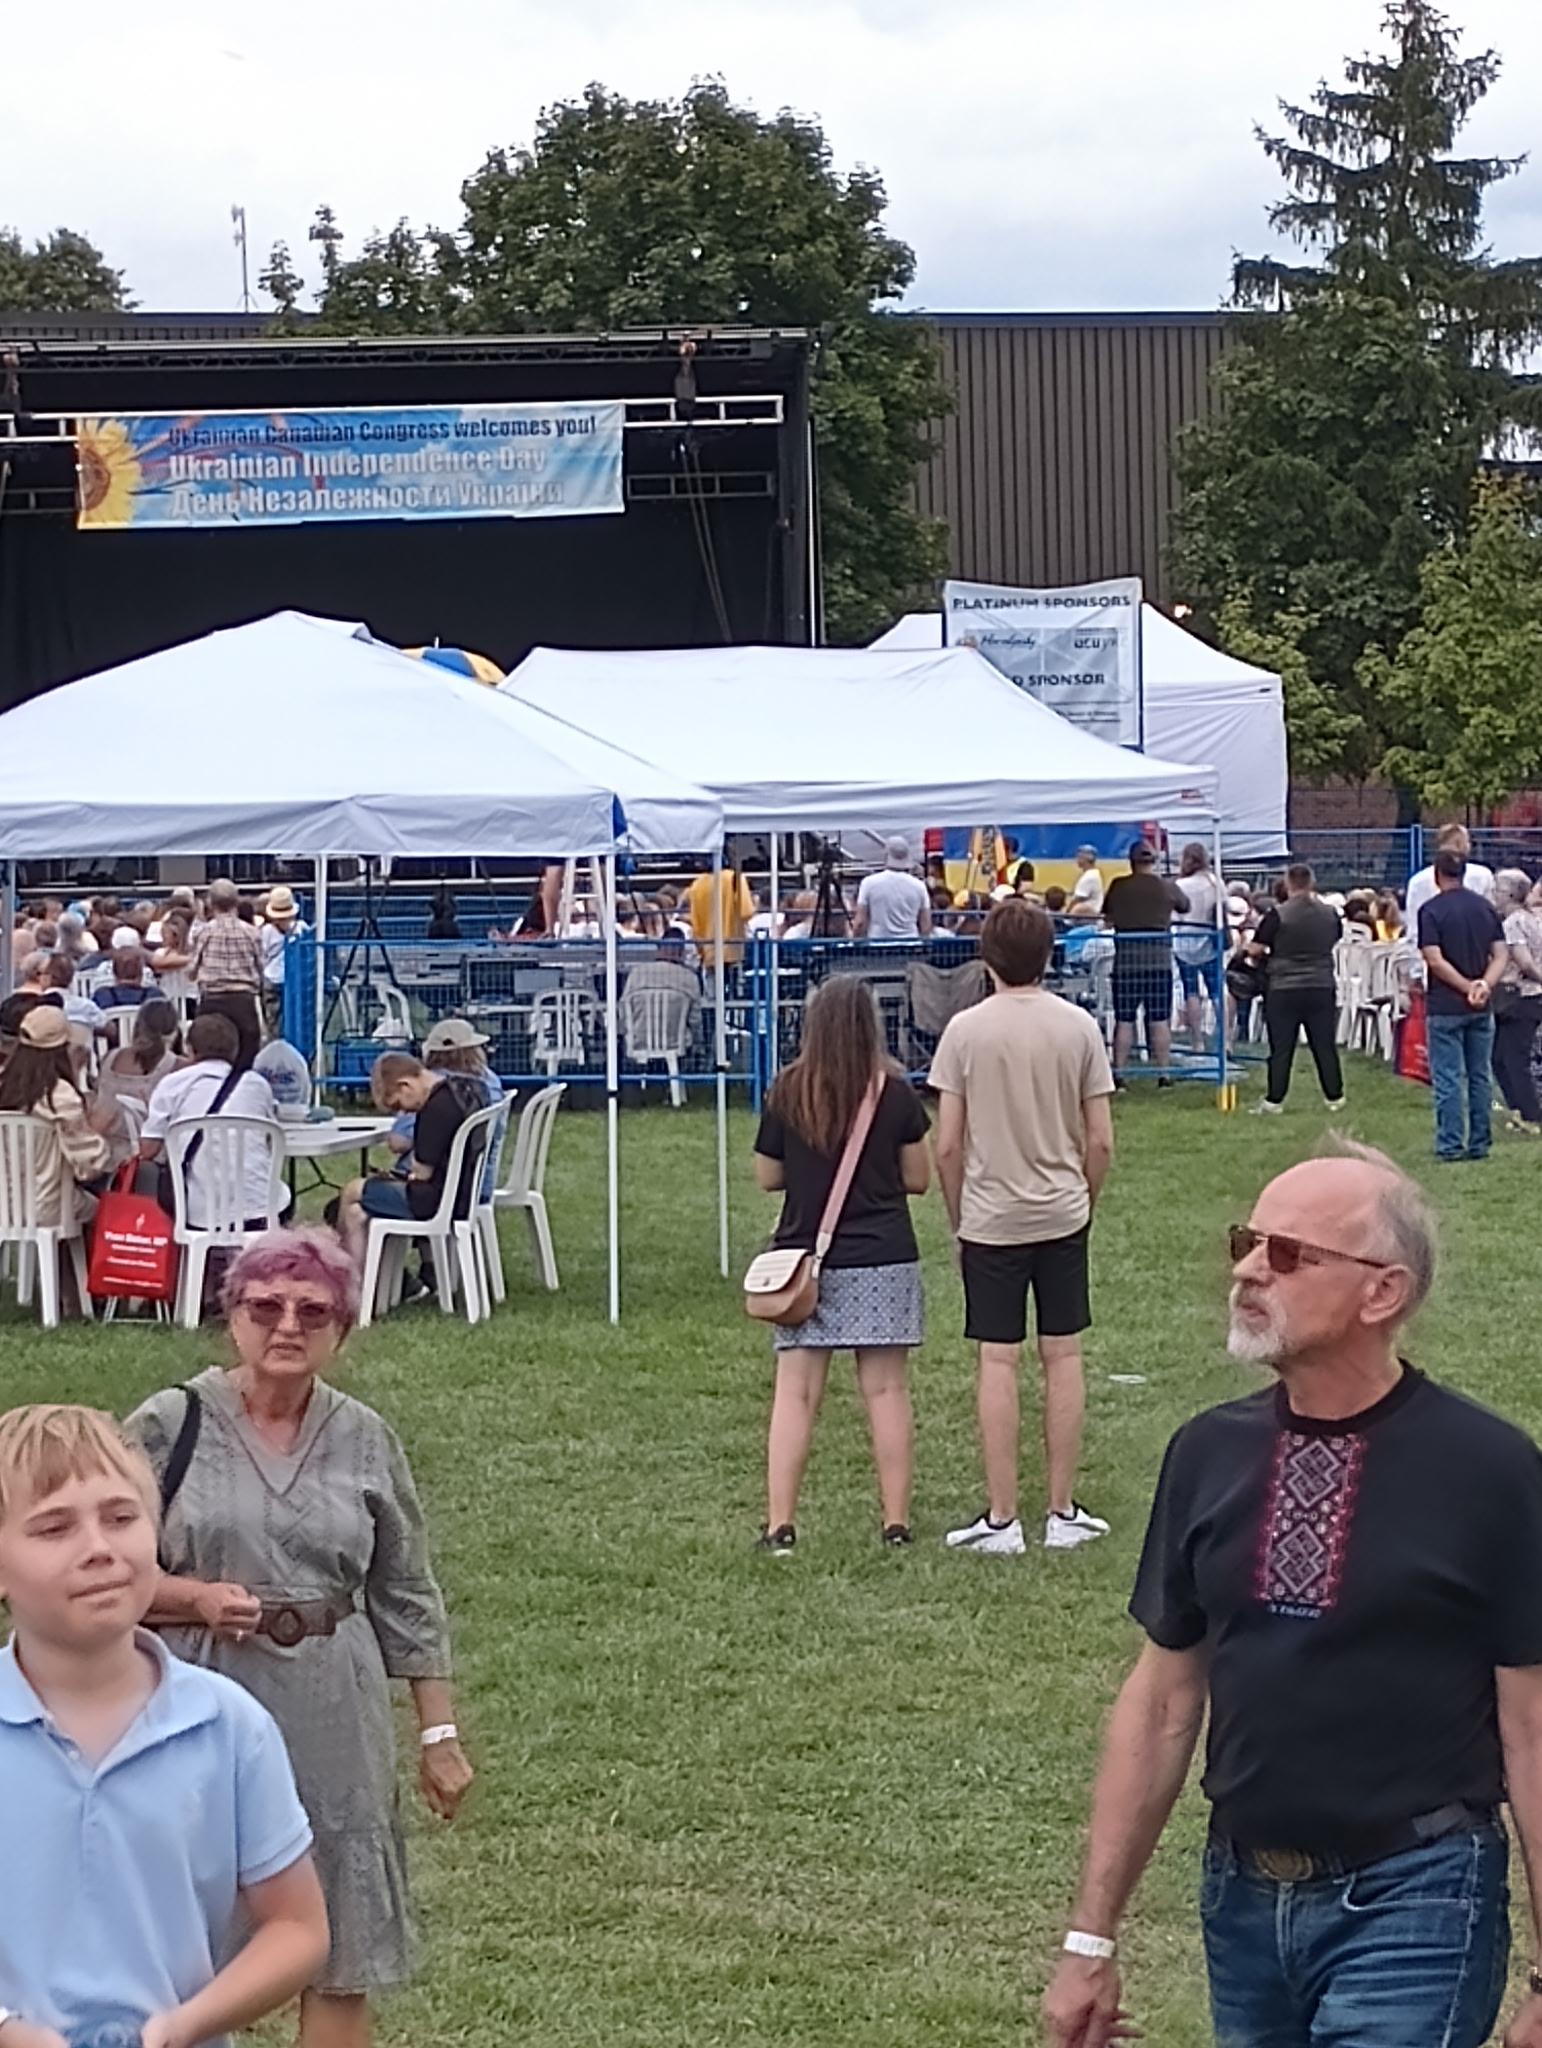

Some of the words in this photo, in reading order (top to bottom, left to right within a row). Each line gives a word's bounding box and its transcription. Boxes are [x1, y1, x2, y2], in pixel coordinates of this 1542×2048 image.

[265, 424, 355, 443] Canadian
[359, 421, 449, 442] Congress
[454, 418, 550, 438] welcomes
[555, 415, 596, 437] you!
[170, 454, 296, 480] Ukrainian
[304, 449, 493, 477] Independence
[500, 447, 546, 473] Day
[171, 488, 240, 520] День
[953, 597, 1038, 610] PLATINUM
[1045, 595, 1130, 609] SPONSORS
[1029, 673, 1105, 687] SPONSOR
